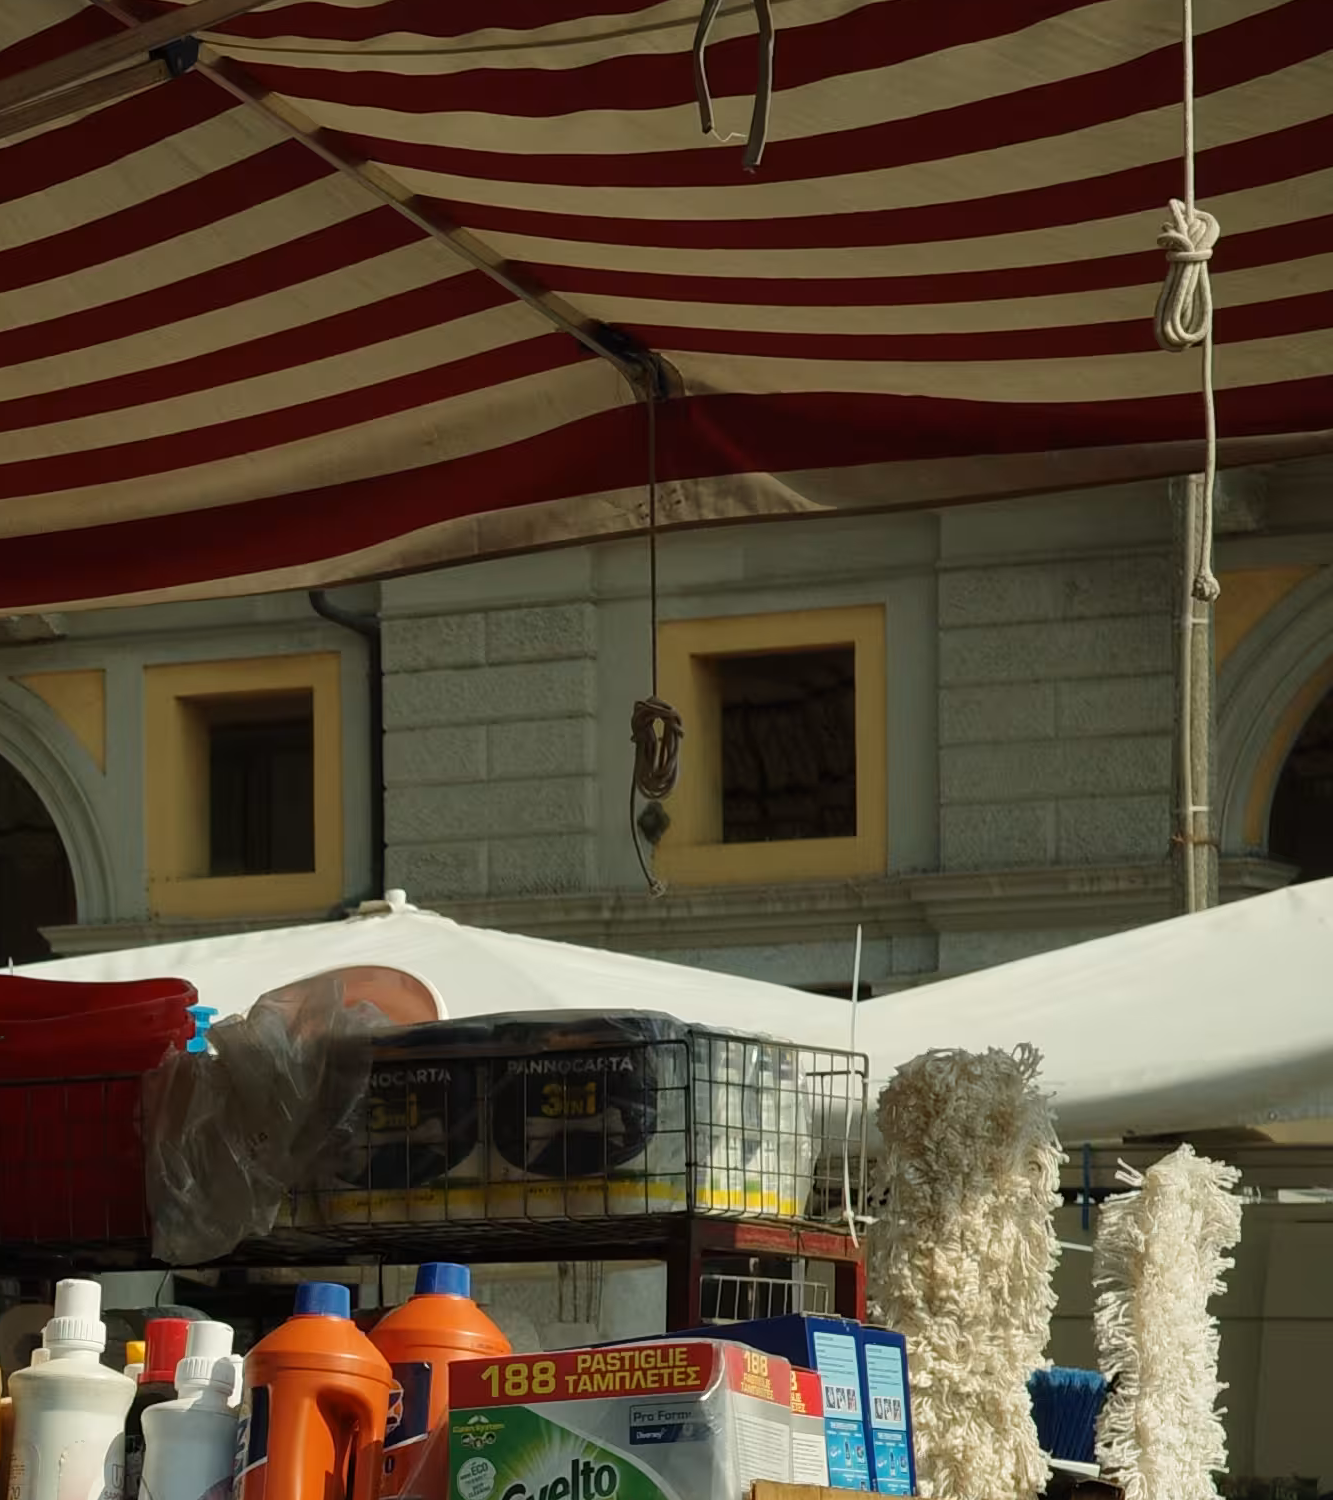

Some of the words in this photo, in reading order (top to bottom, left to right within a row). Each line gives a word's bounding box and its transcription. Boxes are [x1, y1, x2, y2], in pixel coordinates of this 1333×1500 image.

[508, 1056, 634, 1076] PANNOCARTA
[576, 1347, 688, 1373] PASTIGLIE
[481, 1361, 556, 1398] 188
[633, 1410, 656, 1423] Pro
[471, 1462, 489, 1476] ECO
